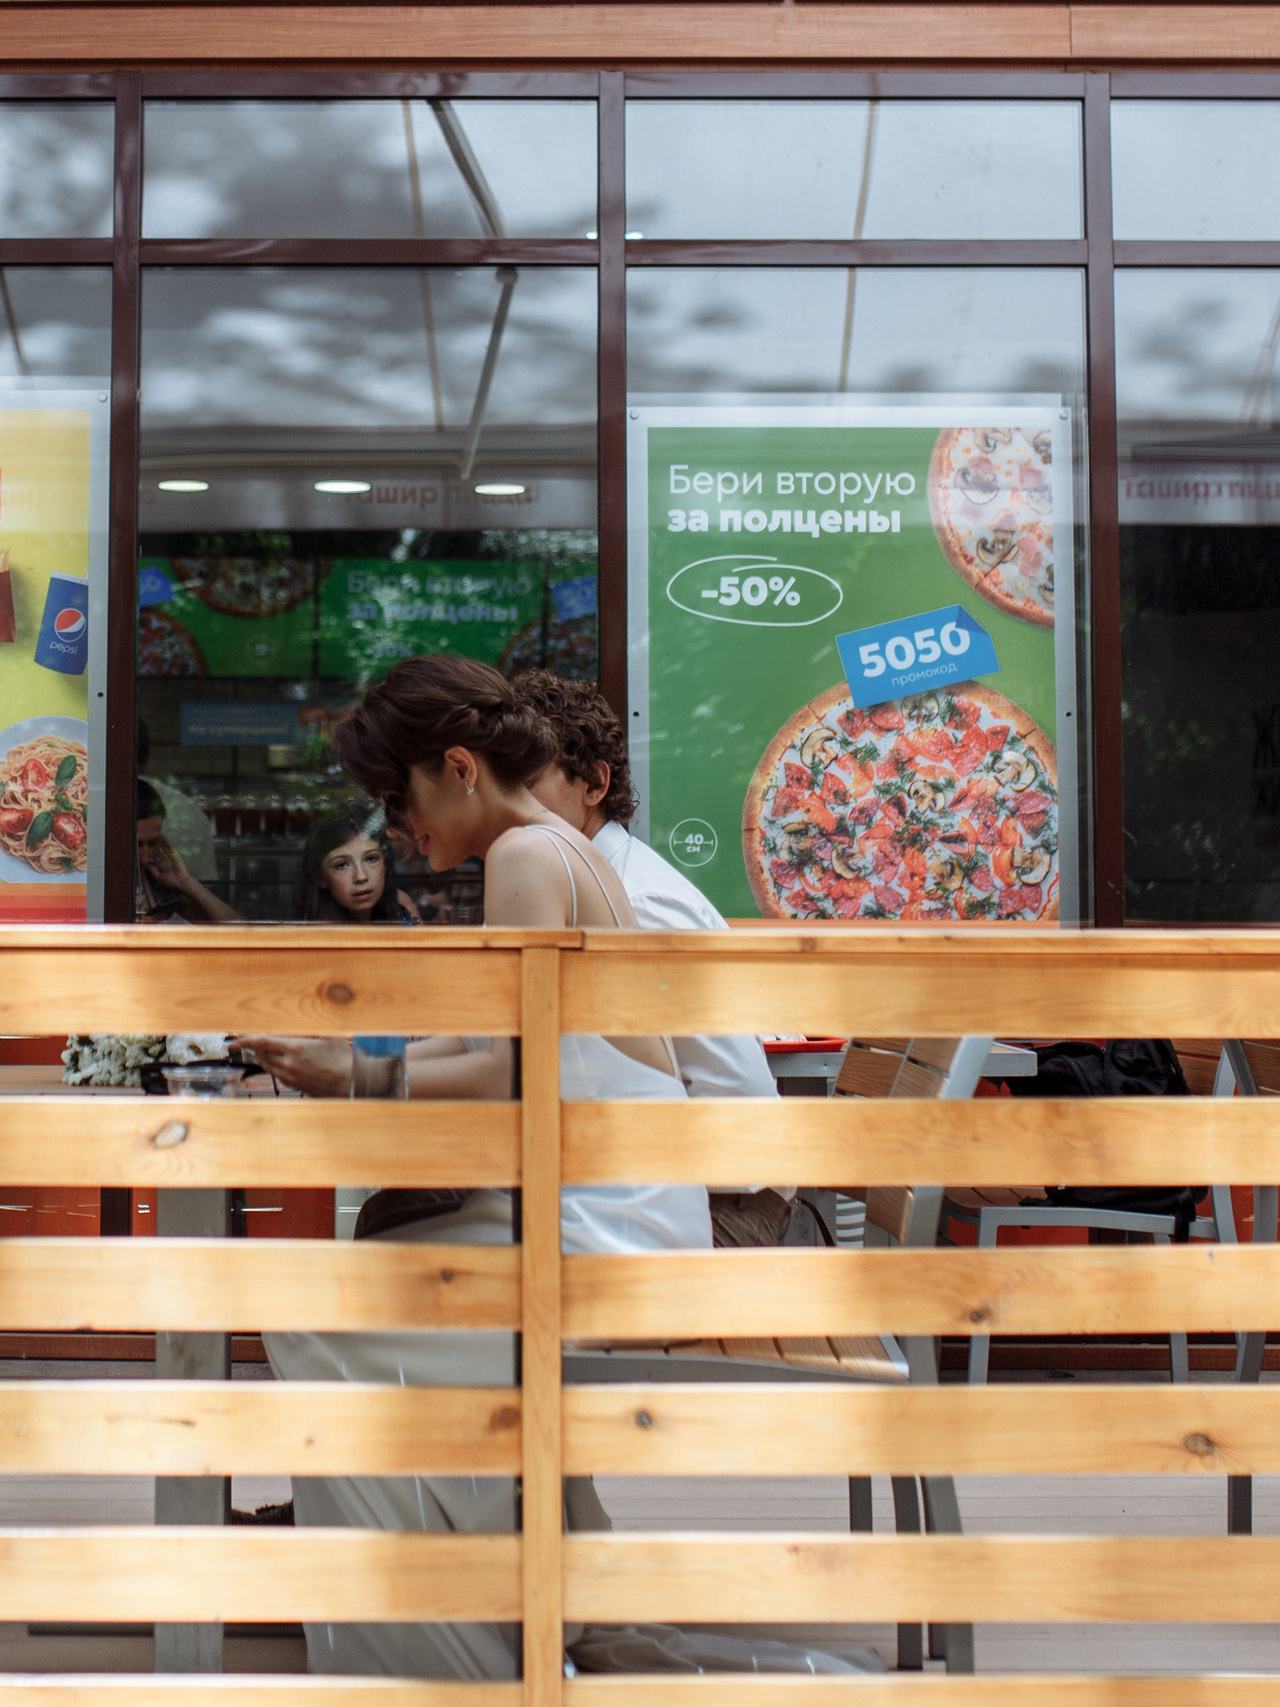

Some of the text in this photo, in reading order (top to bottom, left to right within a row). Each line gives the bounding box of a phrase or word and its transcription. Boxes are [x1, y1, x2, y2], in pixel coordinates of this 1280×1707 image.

[669, 464, 916, 504] Бери вторую
[667, 508, 900, 538] за полцены
[700, 575, 801, 607] -50%
[49, 641, 78, 655] pepsi
[858, 621, 971, 678] 5050
[891, 662, 958, 688] промокод
[684, 833, 704, 845] 40
